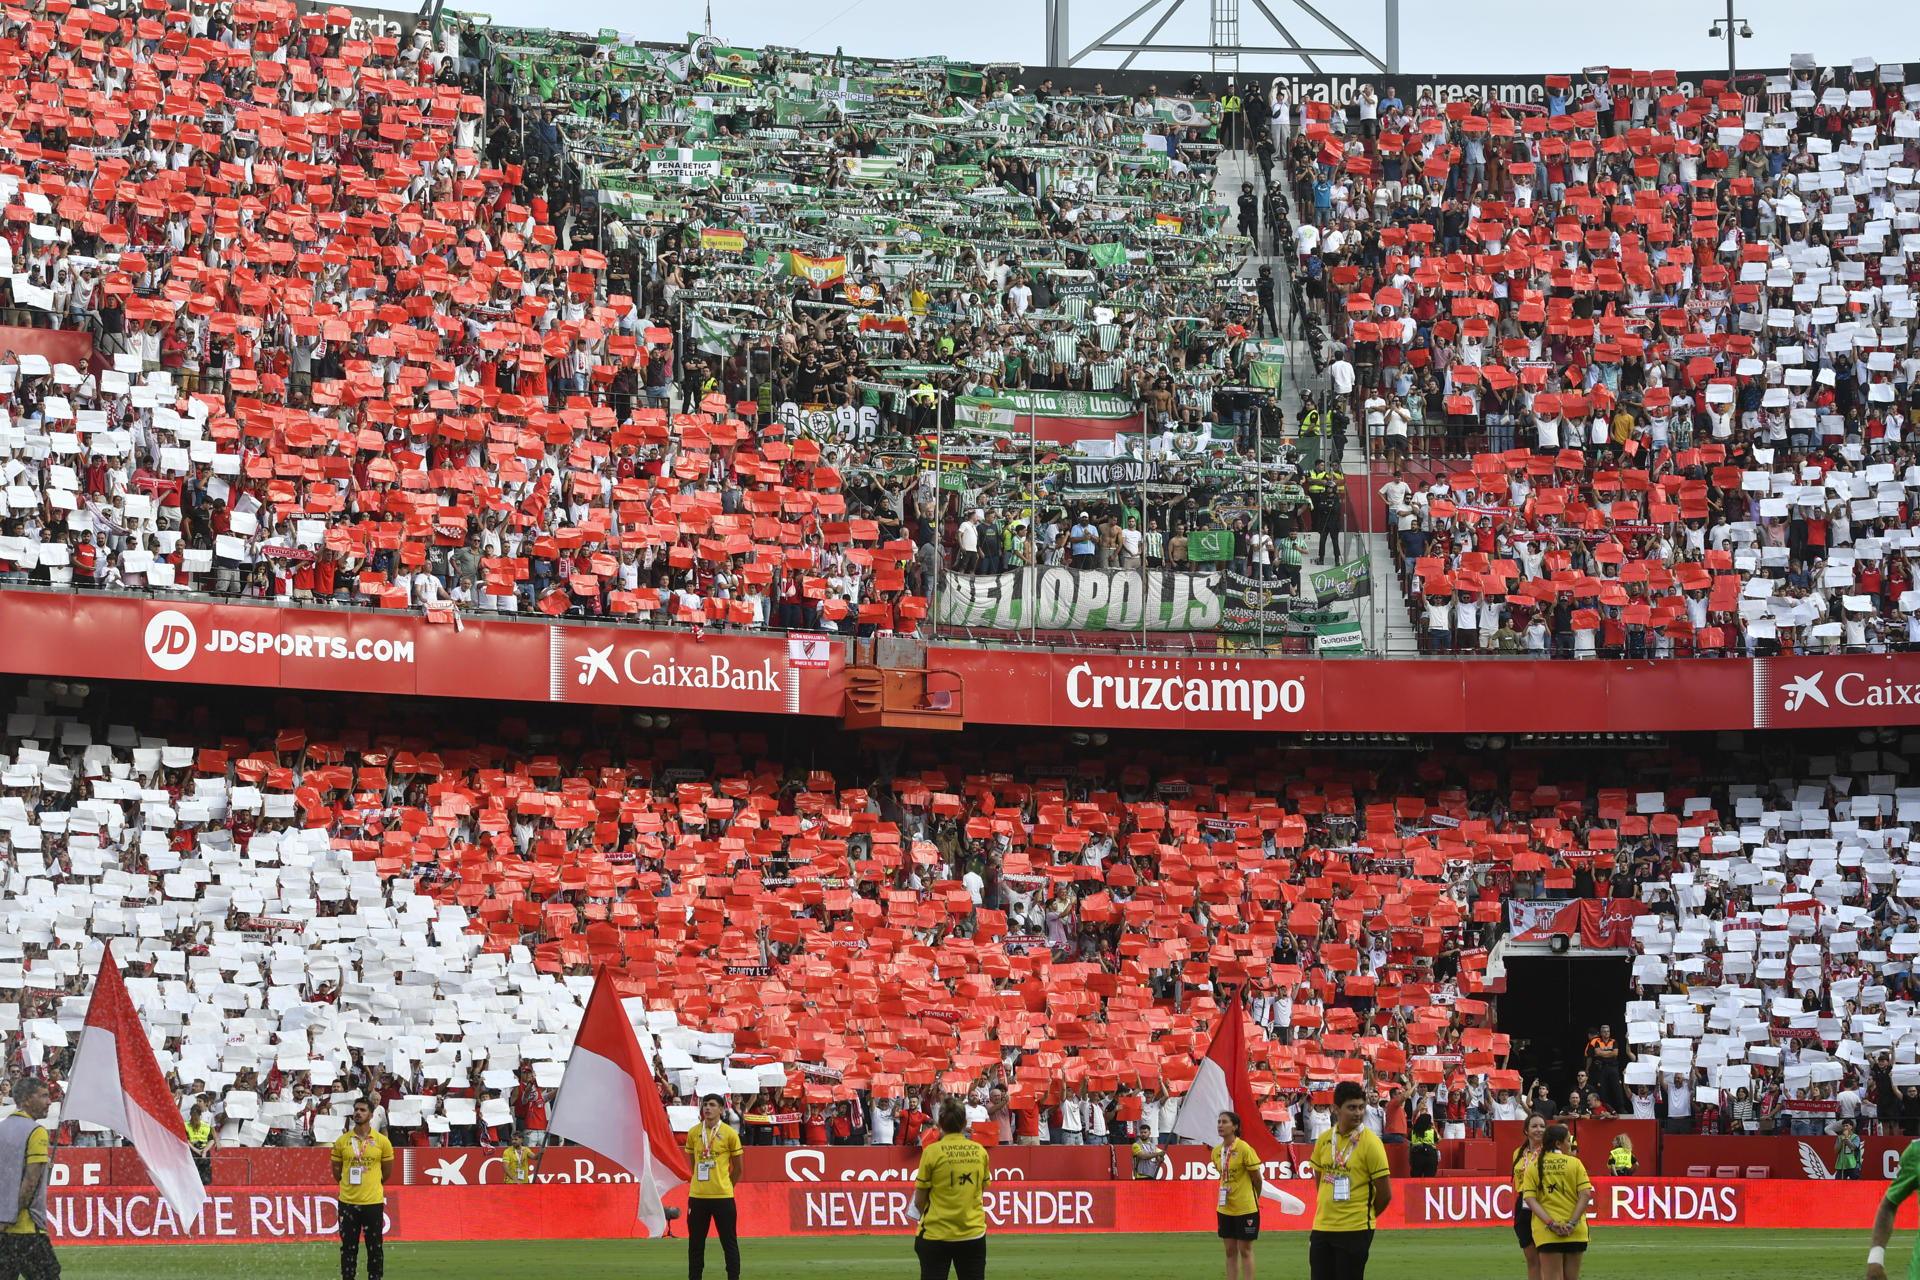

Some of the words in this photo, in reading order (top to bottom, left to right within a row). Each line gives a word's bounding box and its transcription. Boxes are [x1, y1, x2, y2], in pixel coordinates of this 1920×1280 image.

[819, 89, 873, 103] ASARICHE
[1271, 76, 1374, 105] Girald
[982, 121, 1027, 135] OSUNA
[614, 180, 654, 193] CORONIL
[1058, 285, 1095, 295] ALCOLEA
[943, 565, 1222, 630] HELIOPOLIS
[204, 629, 415, 664] JDSPORTS.COM
[1320, 634, 1361, 645] GUADALEMA
[623, 647, 782, 693] CaixaBank
[1128, 659, 1181, 671] DESDE
[1197, 661, 1241, 672] 1904
[1066, 661, 1306, 720] Cruzcampo
[924, 1010, 946, 1018] SEVILLA
[46, 1194, 180, 1237] NUNCA
[806, 1191, 909, 1227] NEVER
[981, 1190, 1097, 1225] RENDER
[1424, 1185, 1513, 1221] NUNC
[1610, 1185, 1737, 1223] RINDAS
